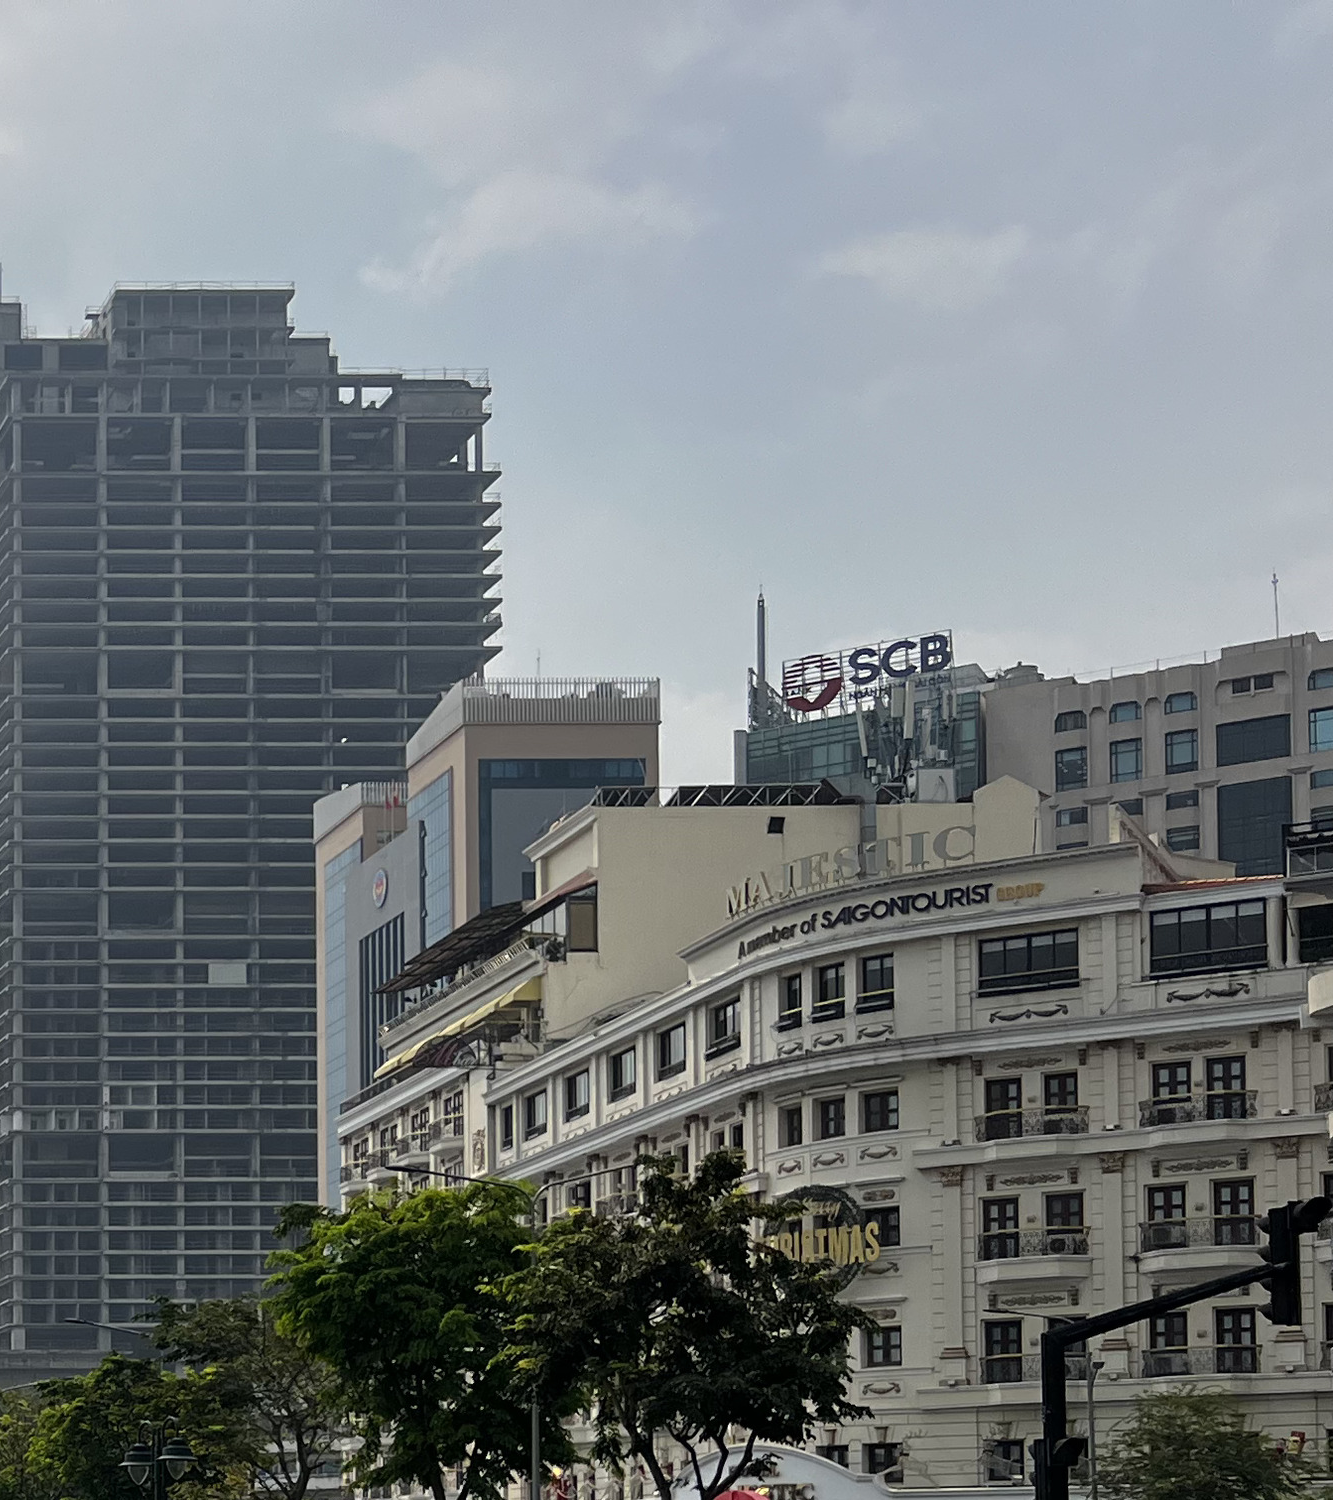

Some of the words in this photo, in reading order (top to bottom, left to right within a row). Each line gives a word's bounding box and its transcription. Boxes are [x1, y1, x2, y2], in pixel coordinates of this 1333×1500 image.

[848, 634, 952, 685] SCB
[726, 825, 977, 918] MAJESTIC
[747, 923, 797, 954] member
[800, 912, 819, 935] of
[821, 882, 995, 930] SAIGONTOURIST
[765, 1221, 880, 1266] RISTMAS
